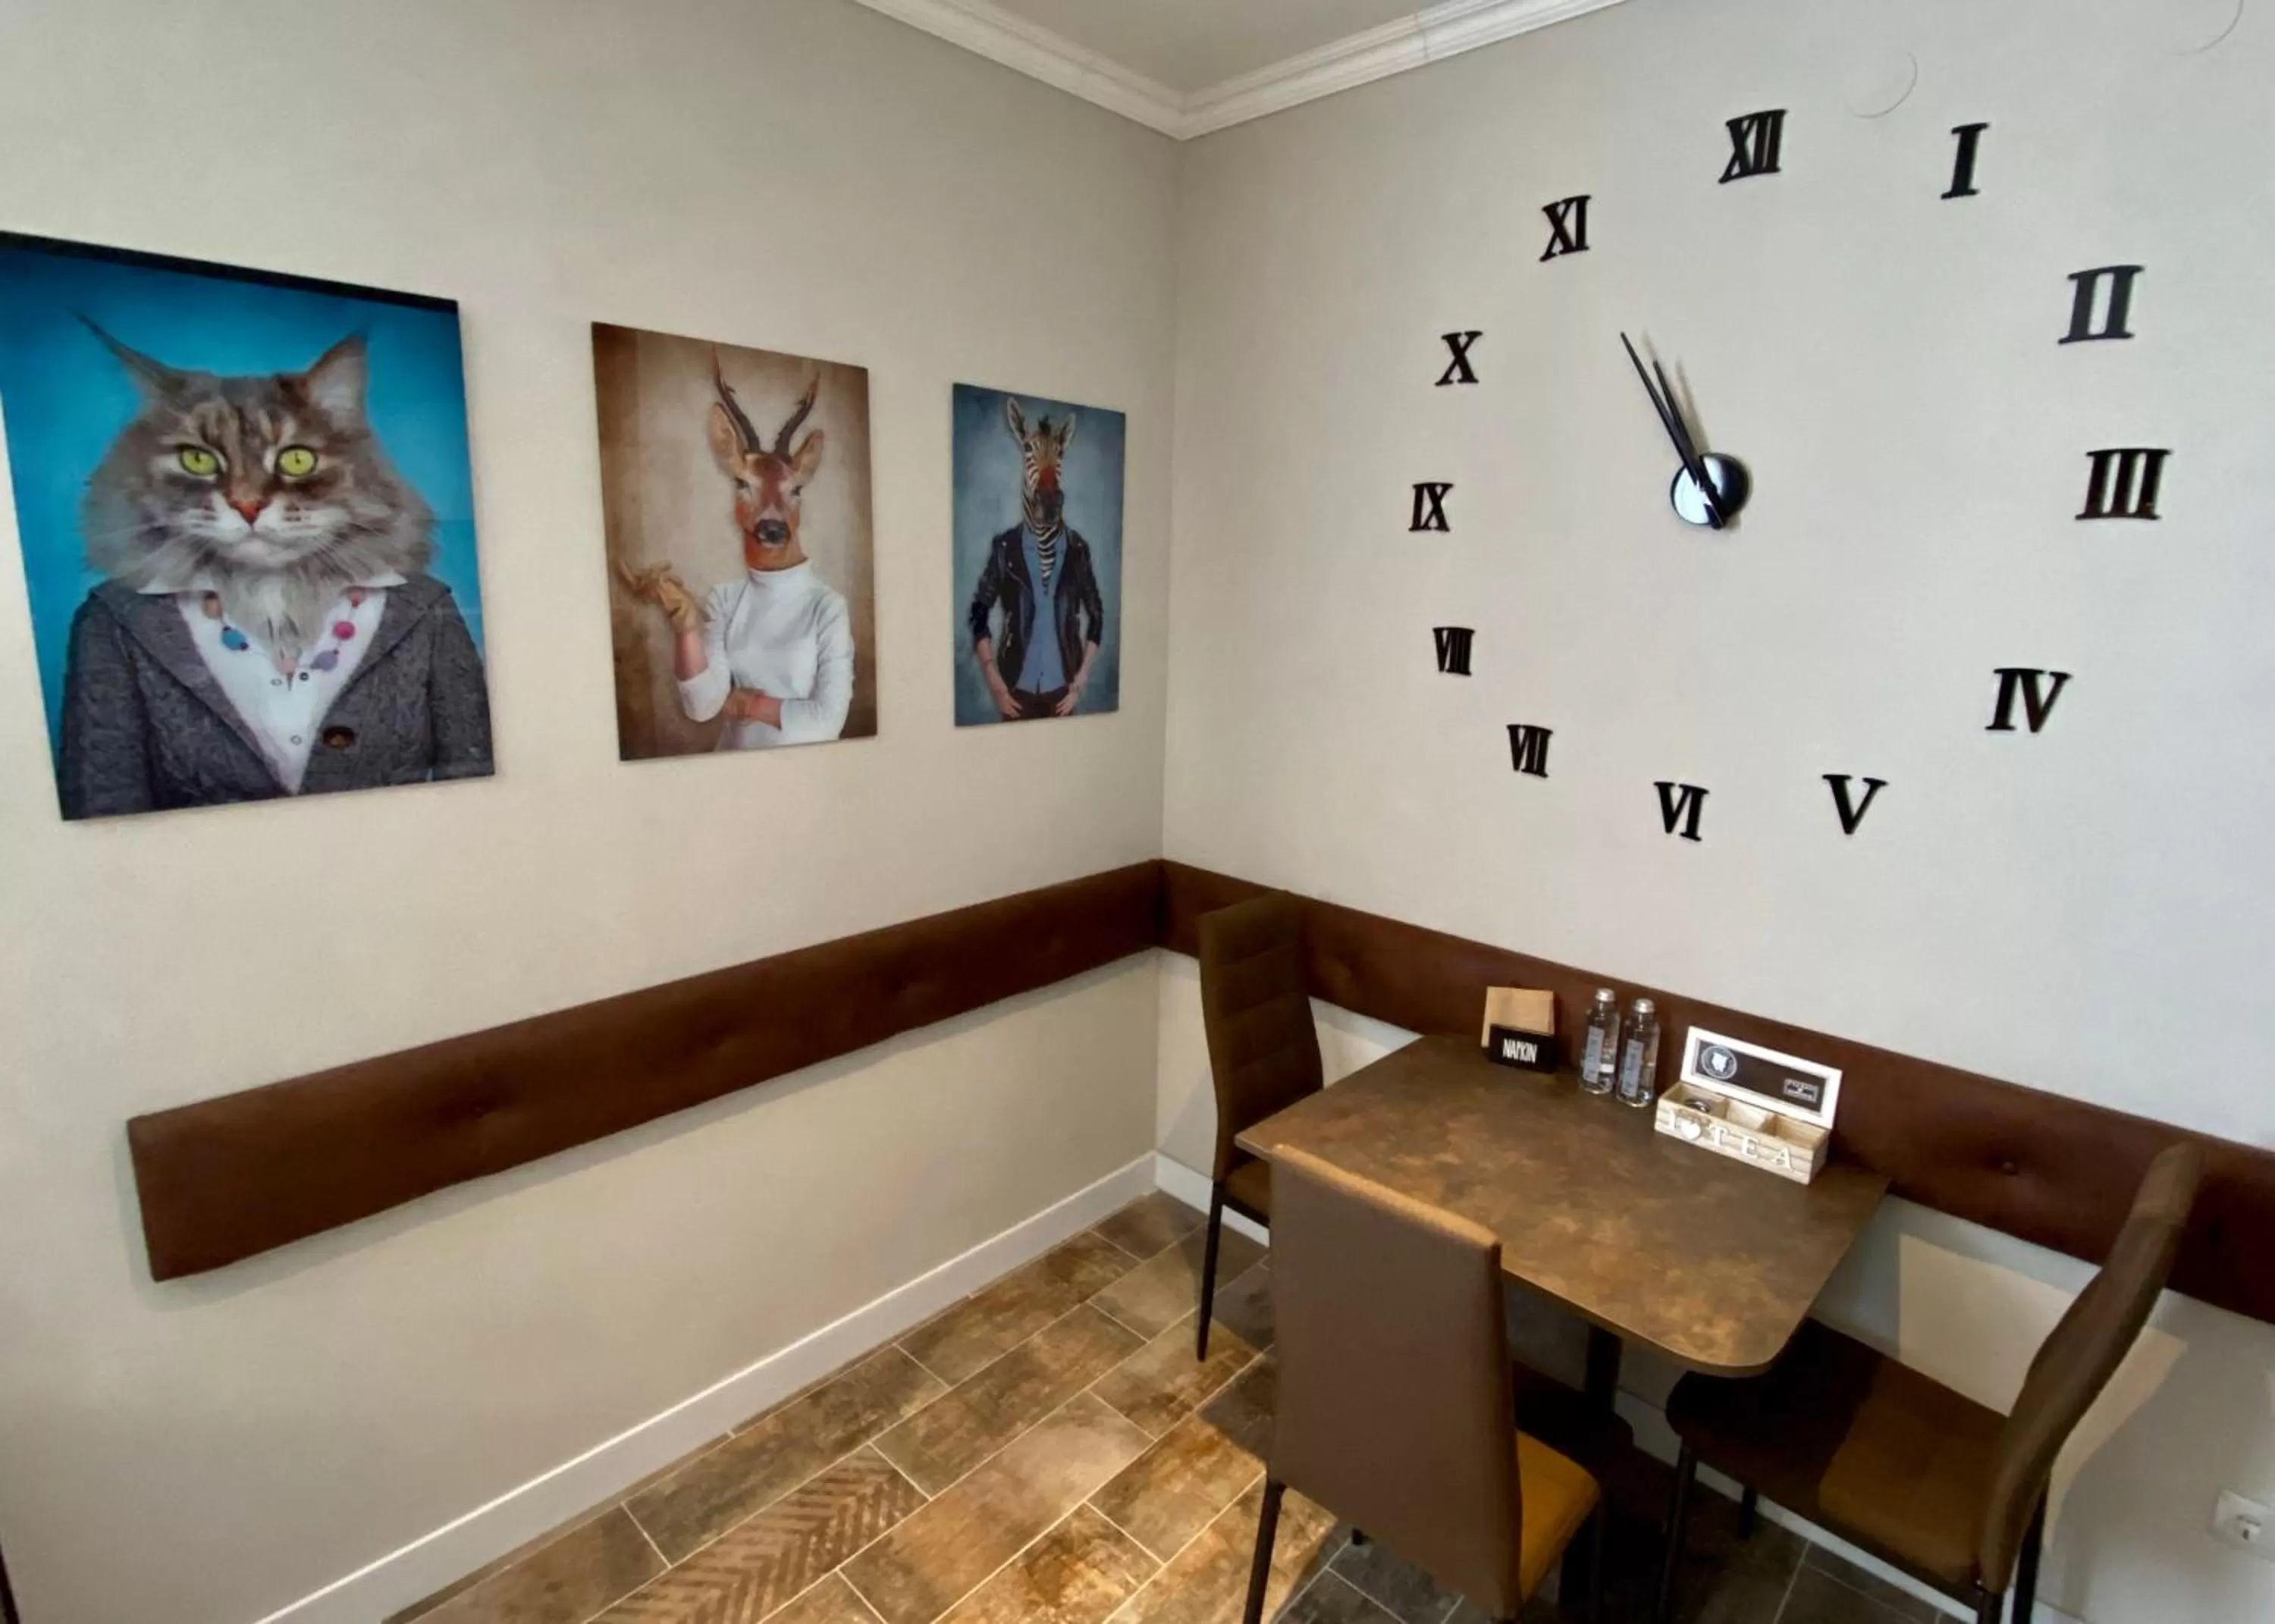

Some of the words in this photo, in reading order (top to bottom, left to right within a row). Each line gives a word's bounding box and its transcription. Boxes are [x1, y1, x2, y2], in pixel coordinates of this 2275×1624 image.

[1718, 109, 1787, 183] XII
[1941, 123, 1988, 199] I
[1540, 196, 1591, 262] XI
[2058, 265, 2143, 344] II
[1436, 331, 1483, 387] X
[1409, 482, 1454, 532] IX
[2076, 448, 2170, 521] III
[1433, 627, 1475, 676] VIII
[1985, 668, 2070, 733] IV
[1506, 724, 1553, 778] VII
[1653, 782, 1709, 842] VI
[1822, 774, 1887, 835] V
[1502, 1037, 1538, 1063] NAPKIN
[1709, 1125, 1794, 1170] TEA
